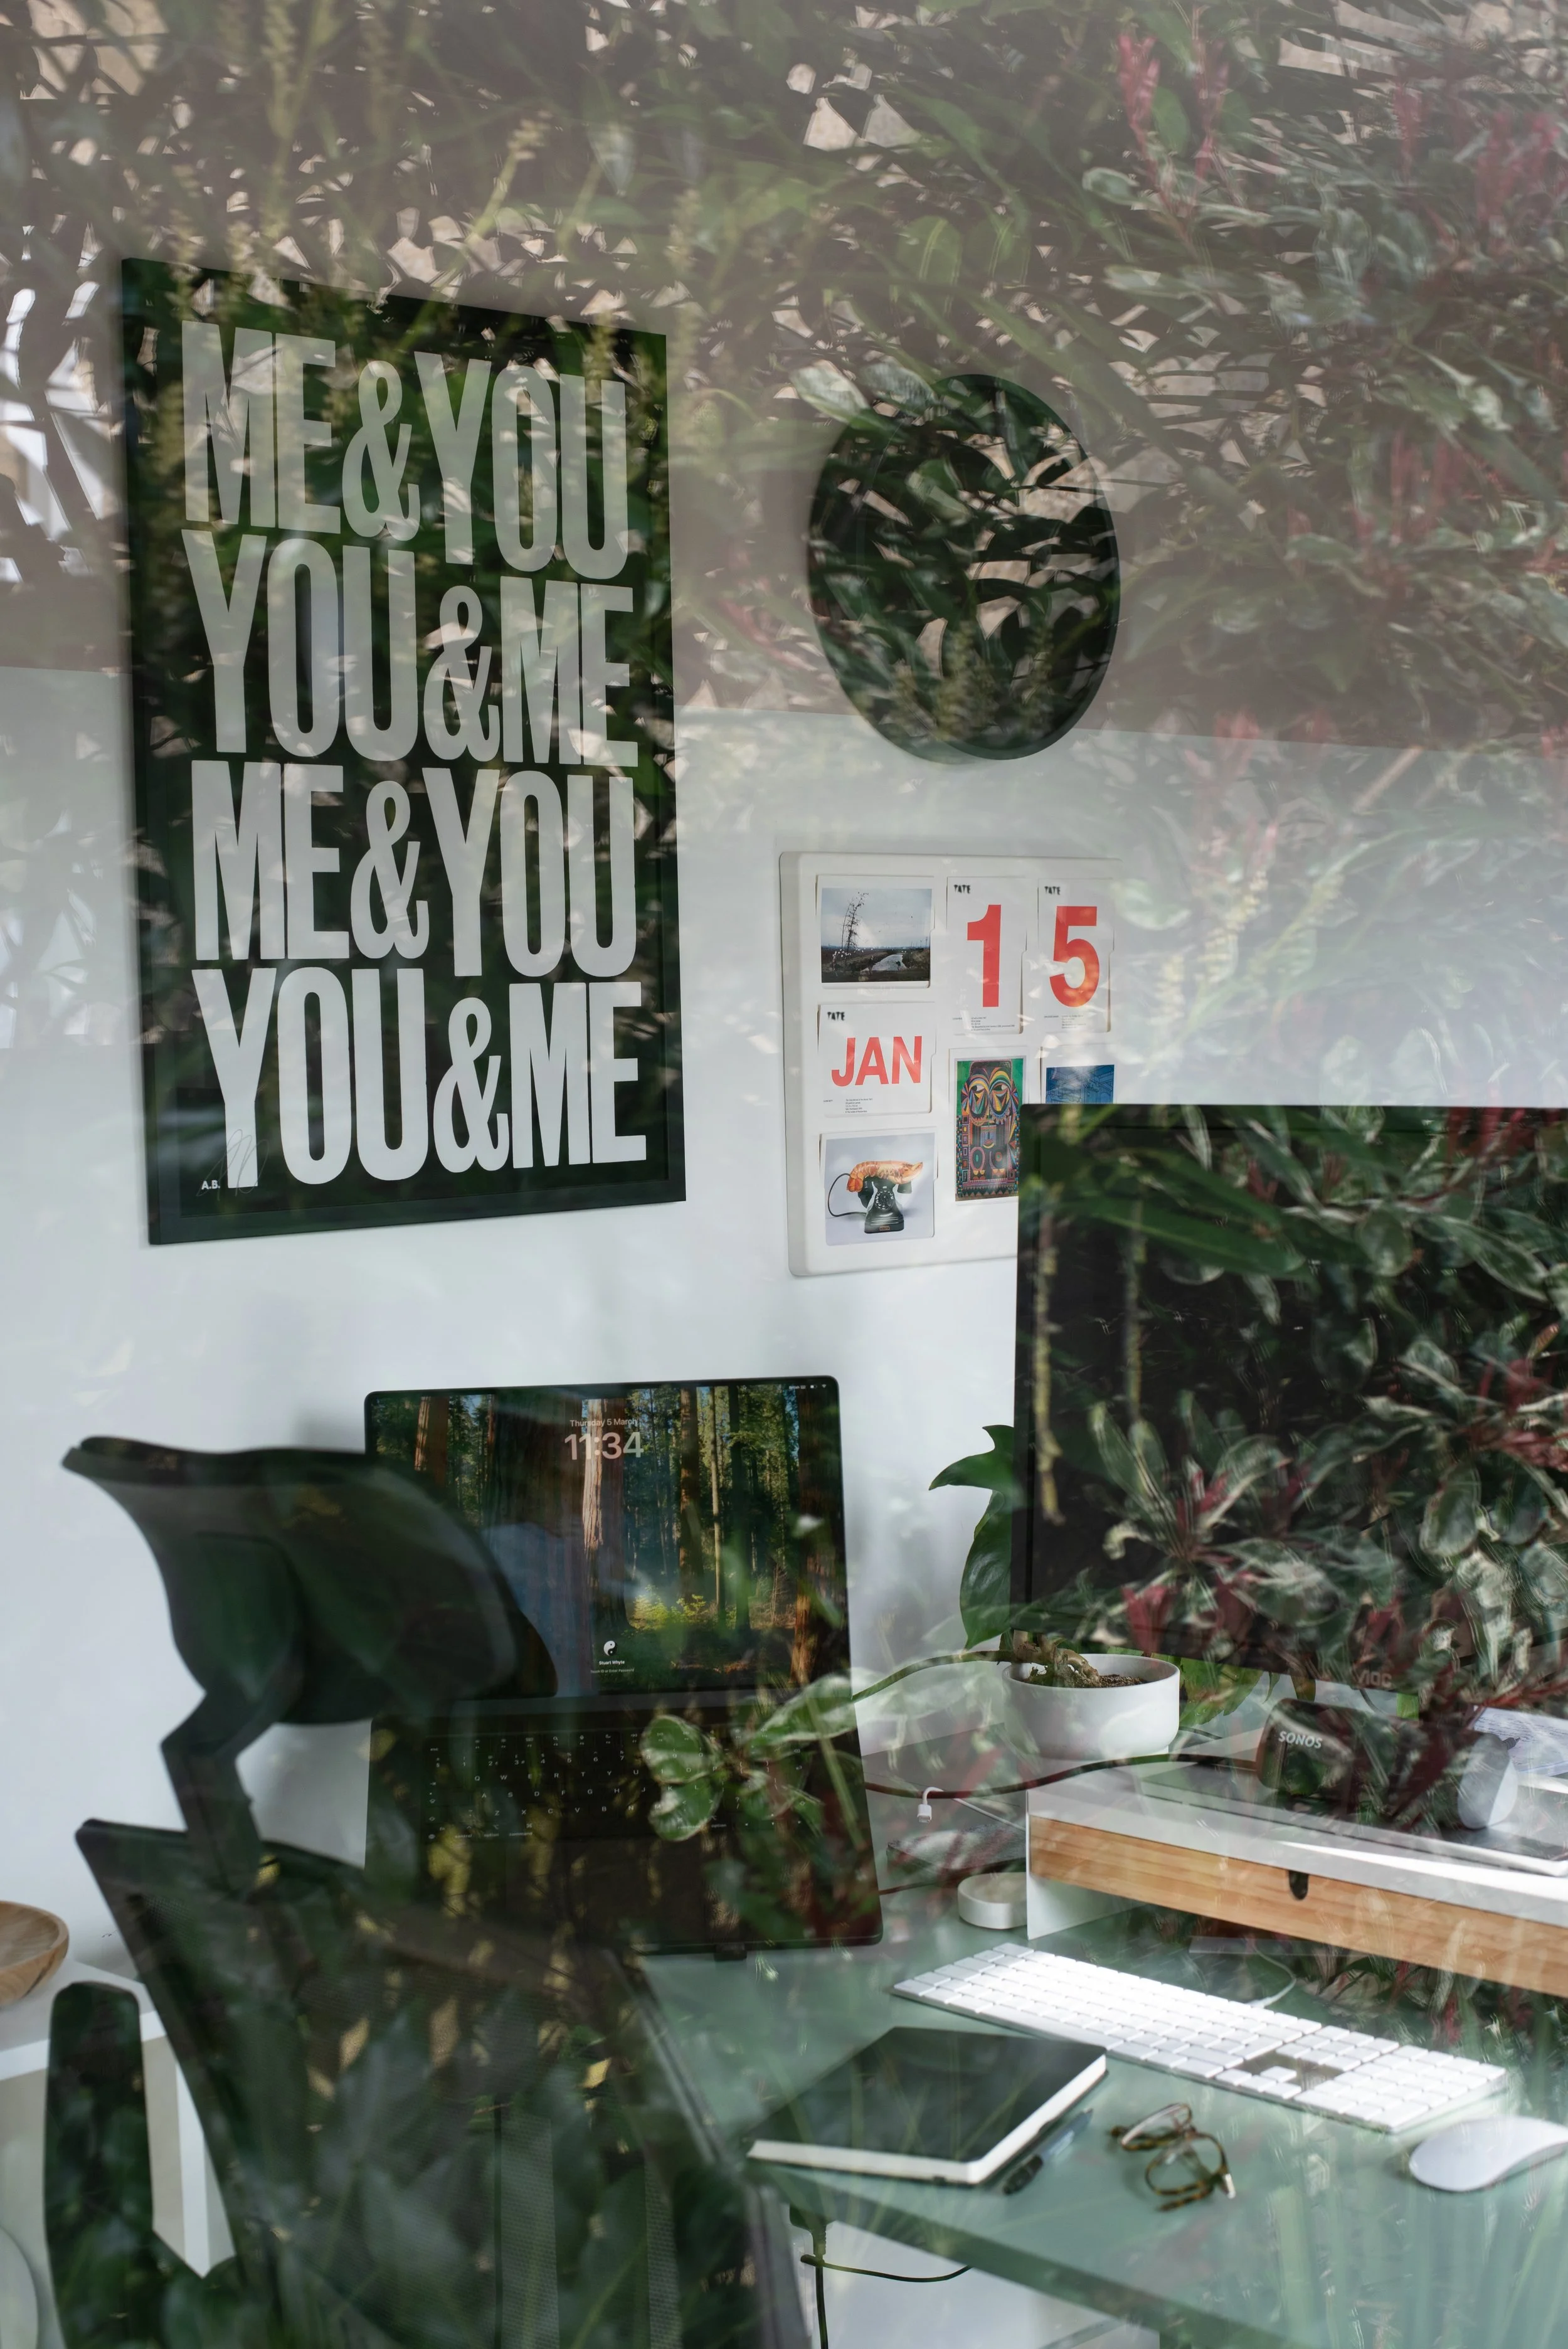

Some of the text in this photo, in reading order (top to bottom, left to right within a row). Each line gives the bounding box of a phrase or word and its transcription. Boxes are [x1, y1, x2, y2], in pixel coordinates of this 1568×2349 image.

[181, 319, 628, 580] ME&YOU
[181, 528, 638, 767] YOU&ME
[191, 759, 637, 977] ME&YOU
[953, 884, 971, 894] TATE
[1044, 886, 1061, 895] TATE
[967, 904, 1002, 1007] 1
[1049, 905, 1100, 1007] 5
[827, 1011, 844, 1021] TATE
[191, 967, 647, 1189] YOU&ME
[831, 1036, 922, 1087] JAN
[201, 1179, 221, 1190] A.B.
[613, 1418, 638, 1426] March
[564, 1431, 644, 1460] 11:34
[1278, 1731, 1323, 1749] SONOS
